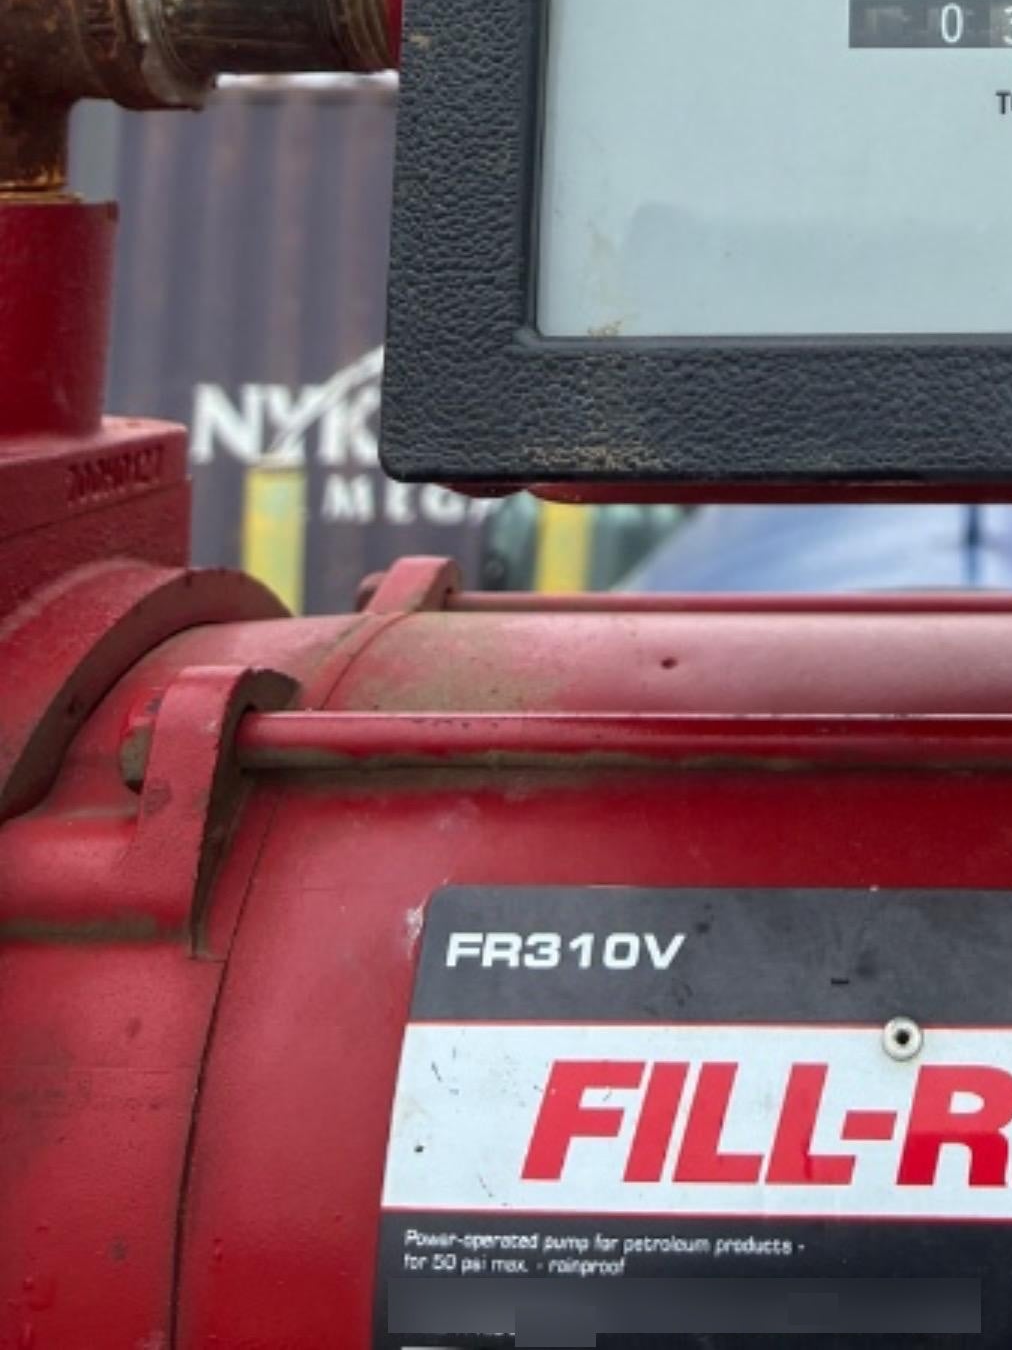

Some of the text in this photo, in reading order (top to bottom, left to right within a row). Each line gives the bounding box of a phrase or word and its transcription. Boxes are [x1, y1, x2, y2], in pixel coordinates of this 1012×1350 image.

[445, 932, 686, 970] FR310V
[404, 1229, 539, 1251] Power-operated
[543, 1235, 590, 1254] pump
[594, 1233, 619, 1251] for
[623, 1235, 709, 1255] petroleum
[714, 1236, 792, 1257] products
[404, 1253, 428, 1270] for
[432, 1253, 457, 1271] 50
[461, 1254, 486, 1276] psi
[548, 1256, 627, 1278] rainproof
